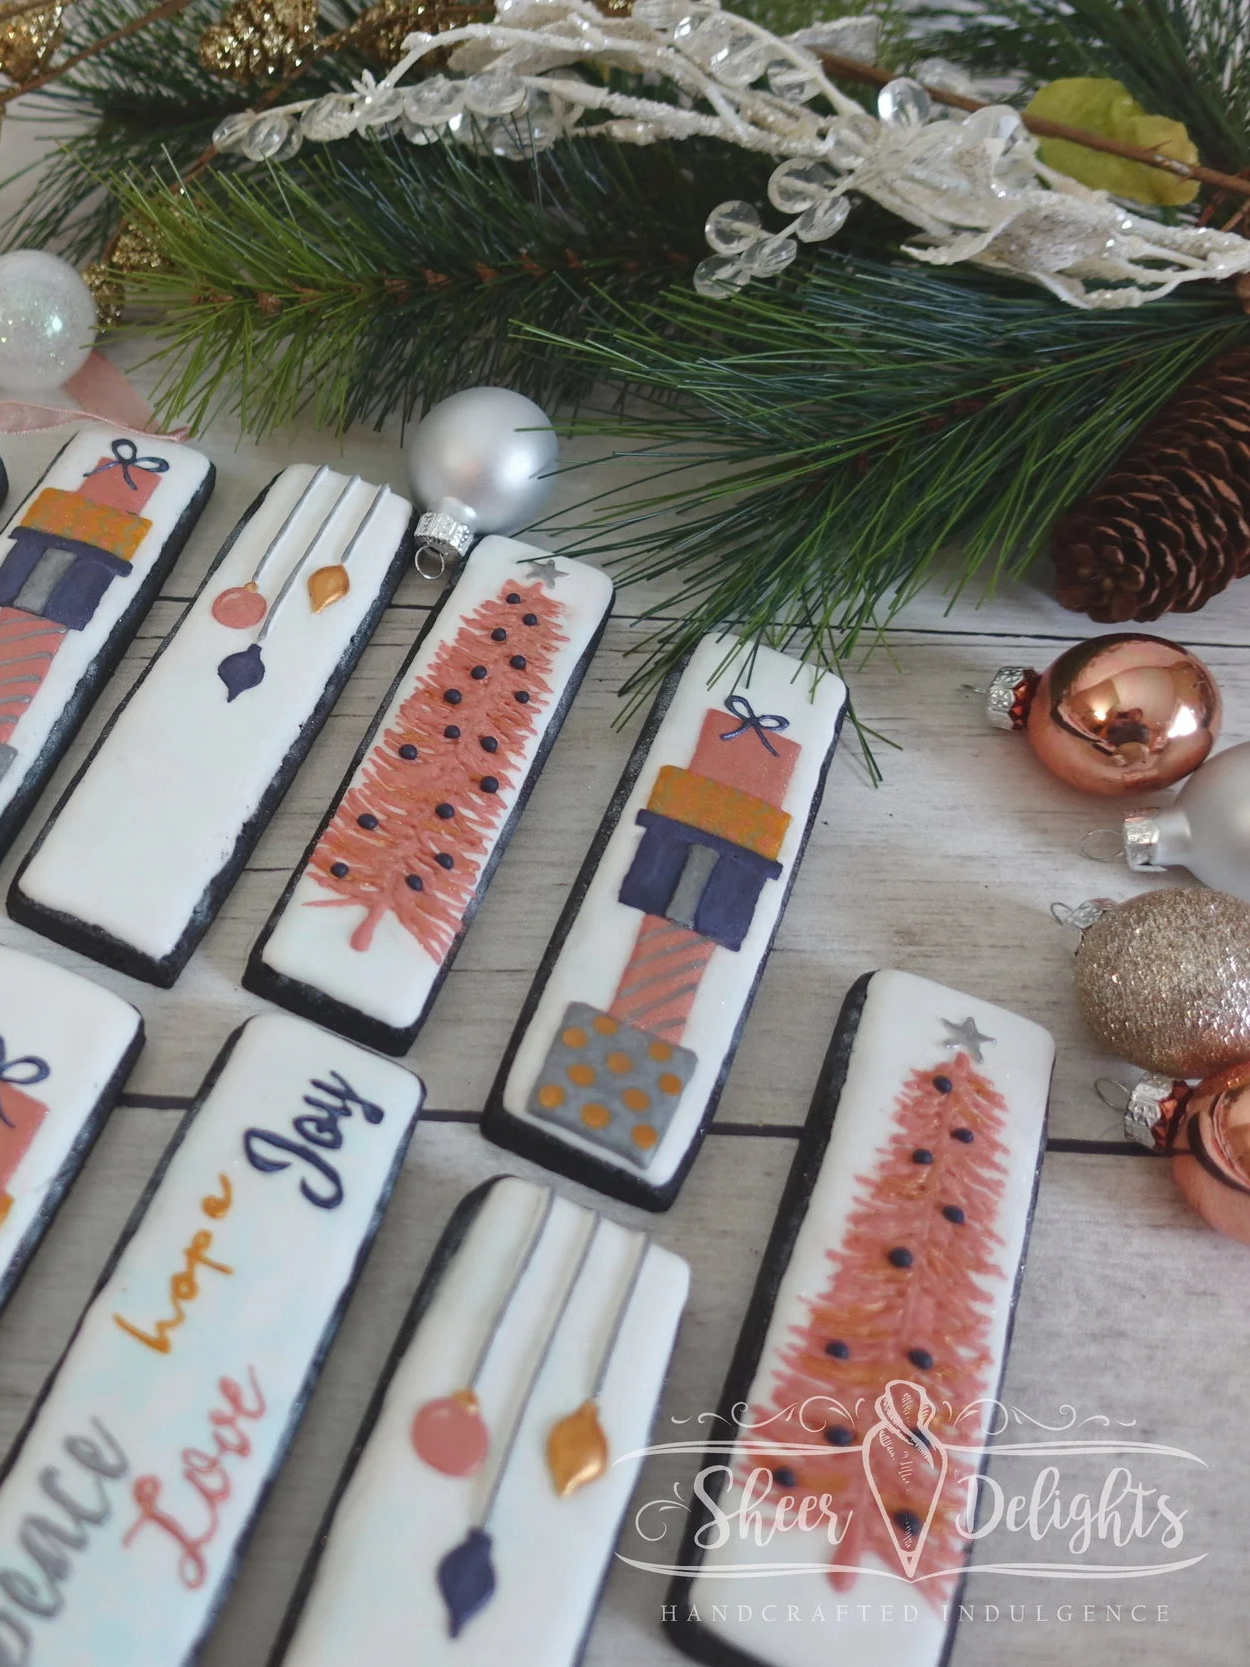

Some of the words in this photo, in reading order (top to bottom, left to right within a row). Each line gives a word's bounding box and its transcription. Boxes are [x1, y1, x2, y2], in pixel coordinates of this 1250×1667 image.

[242, 1069, 385, 1210] Joy
[111, 1171, 235, 1355] hope
[120, 1362, 267, 1592] Love
